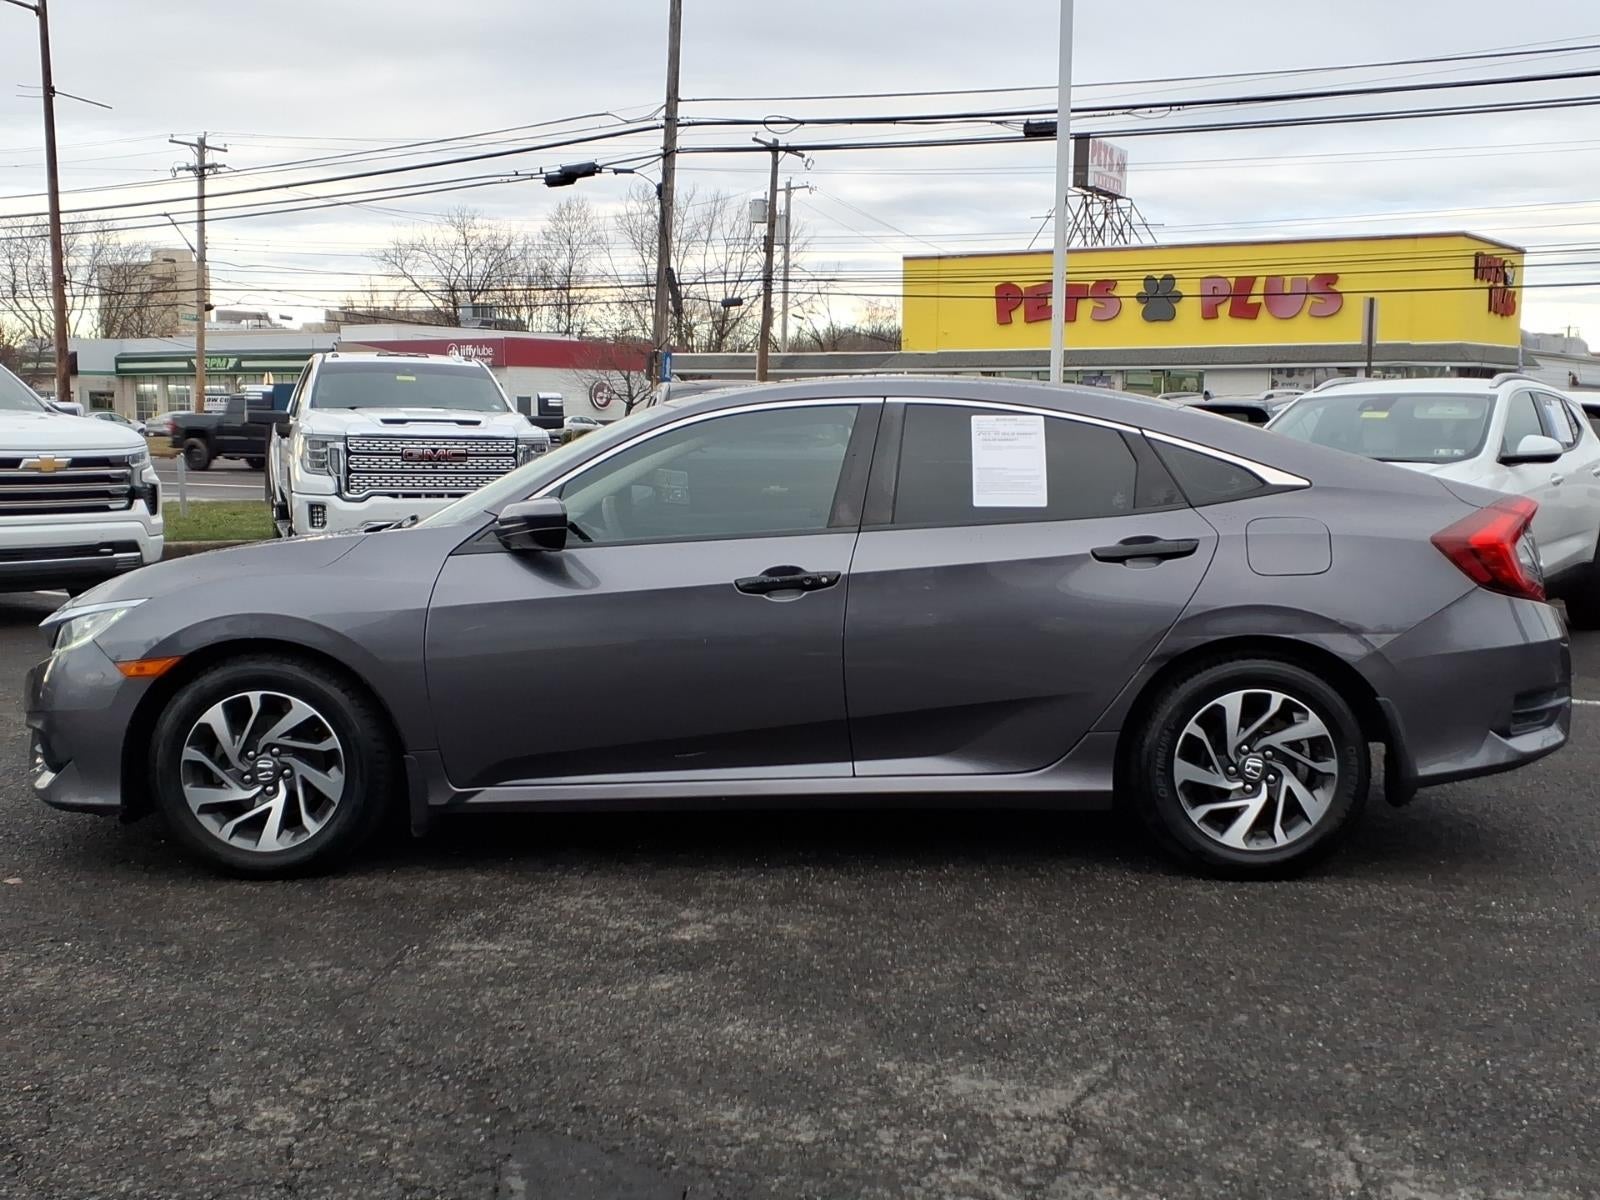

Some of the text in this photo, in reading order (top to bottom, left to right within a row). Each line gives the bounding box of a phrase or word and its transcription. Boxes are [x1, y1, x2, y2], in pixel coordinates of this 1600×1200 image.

[994, 273, 1344, 324] PETS PLUS
[403, 448, 467, 462] GMC
